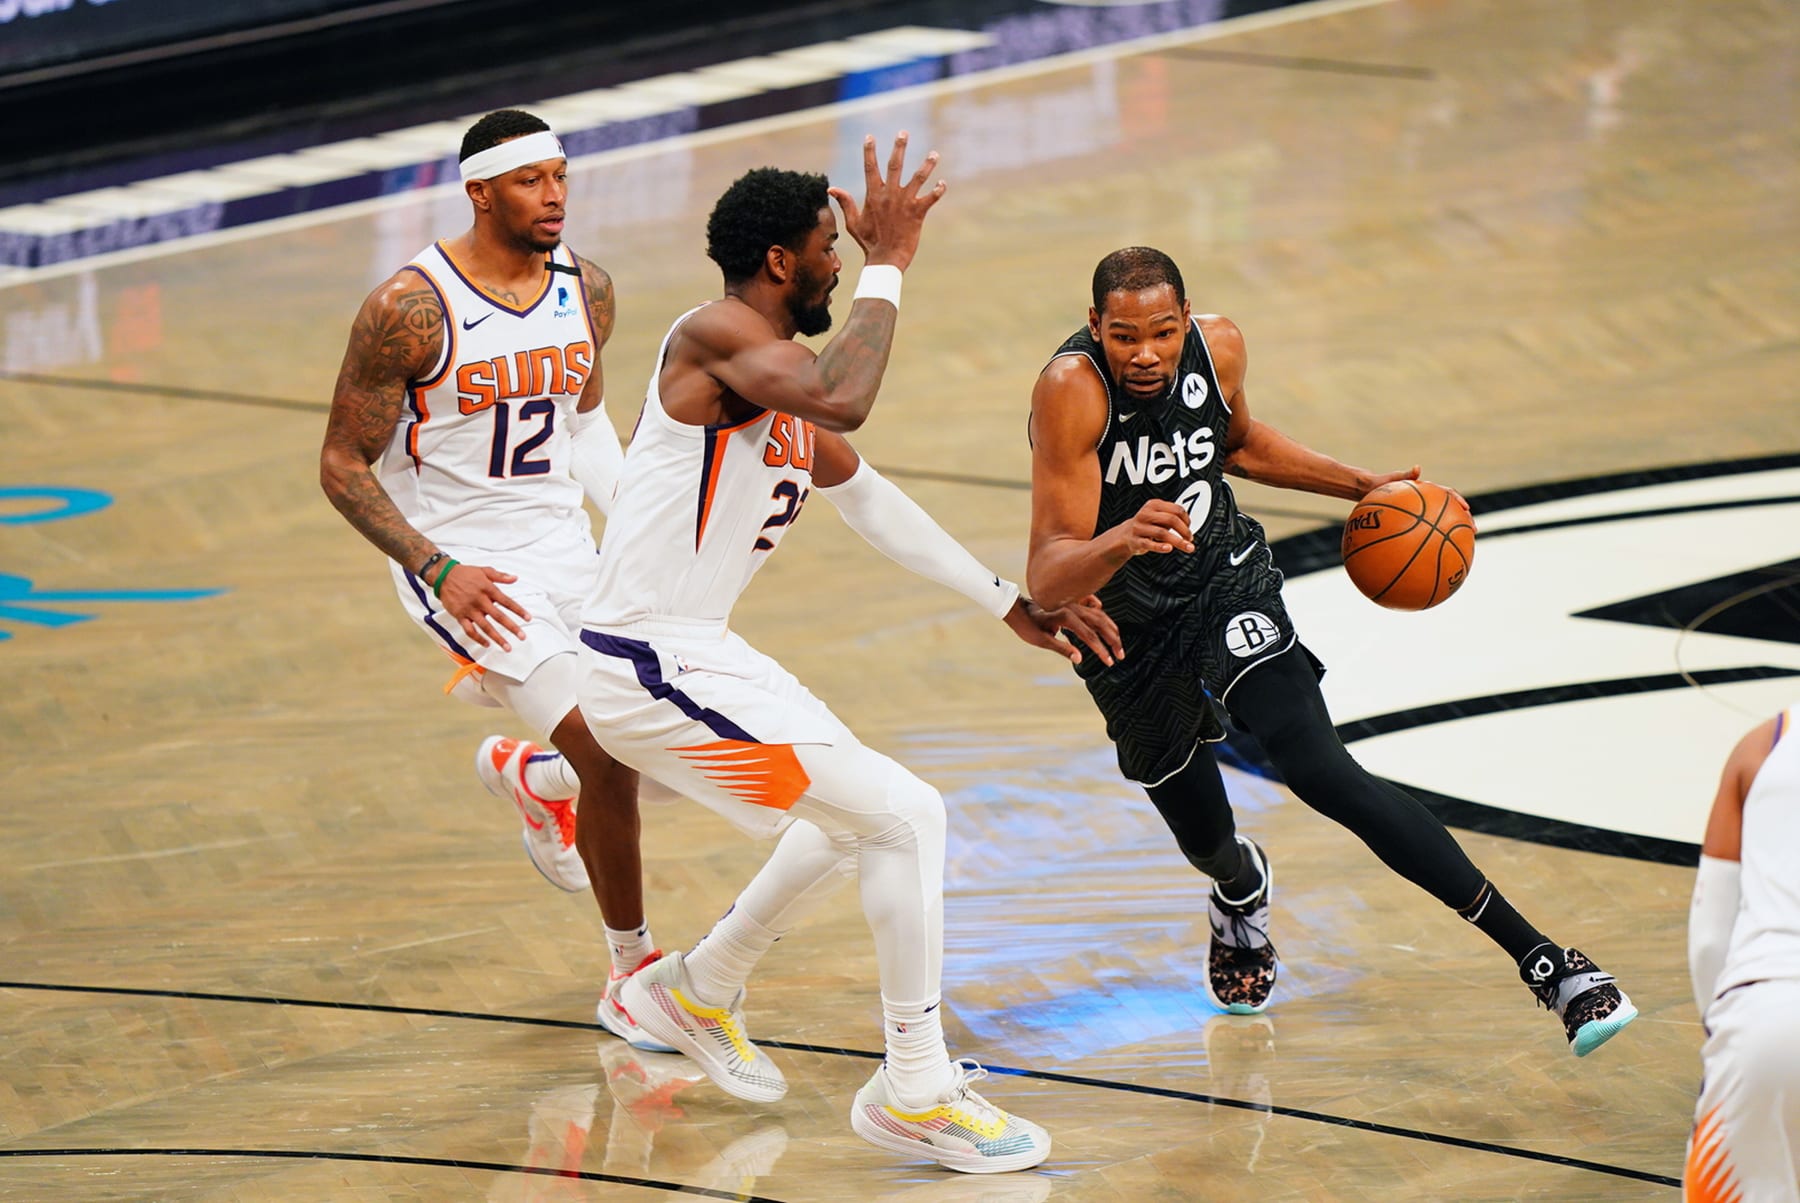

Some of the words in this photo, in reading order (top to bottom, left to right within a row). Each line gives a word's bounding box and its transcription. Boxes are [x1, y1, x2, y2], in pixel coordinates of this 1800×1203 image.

[554, 308, 578, 318] PayPal
[488, 397, 556, 479] 12
[762, 411, 816, 475] SU
[1105, 426, 1214, 486] Nets
[751, 479, 810, 553] 2
[1239, 617, 1266, 650] B
